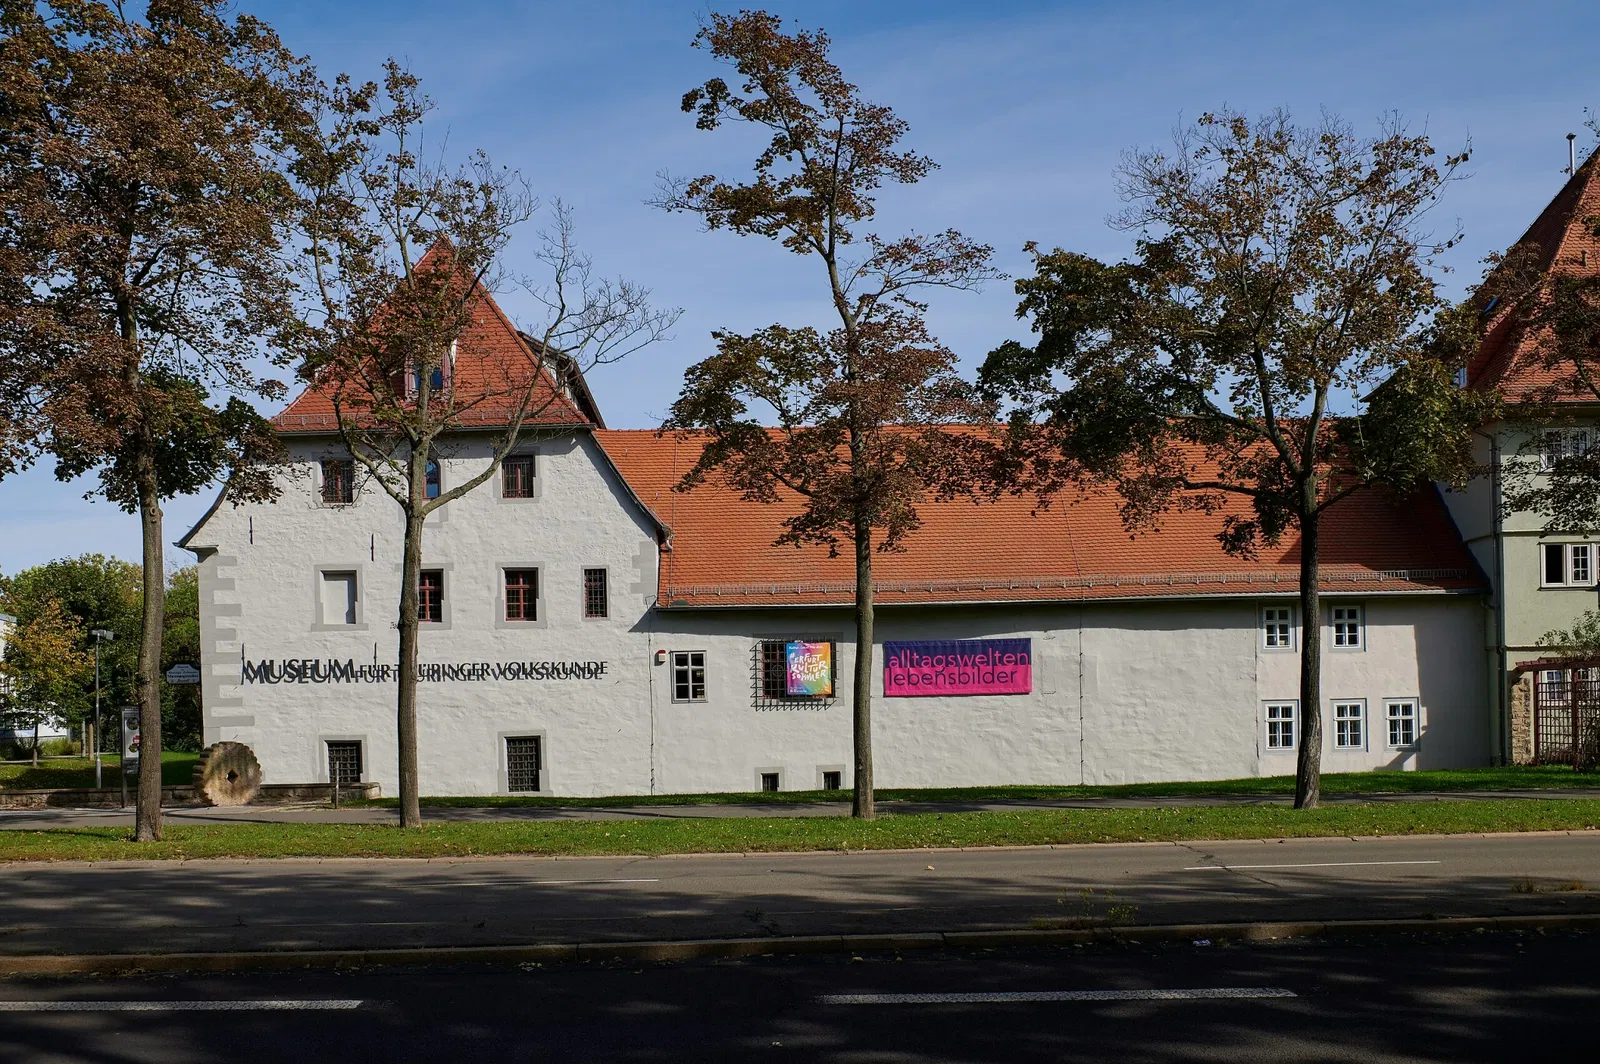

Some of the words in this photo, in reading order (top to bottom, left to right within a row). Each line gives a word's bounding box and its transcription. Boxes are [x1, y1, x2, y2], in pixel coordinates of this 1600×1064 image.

[245, 658, 355, 680] MUSEUM
[361, 664, 391, 678] FÜR
[394, 662, 491, 678] ÜRINGER
[496, 661, 608, 677] VOLKSKUNDE
[791, 661, 828, 673] KULTUR
[889, 648, 1029, 672] alltagswelten
[792, 670, 826, 682] SOMMER
[889, 665, 1018, 686] lebensbilder
